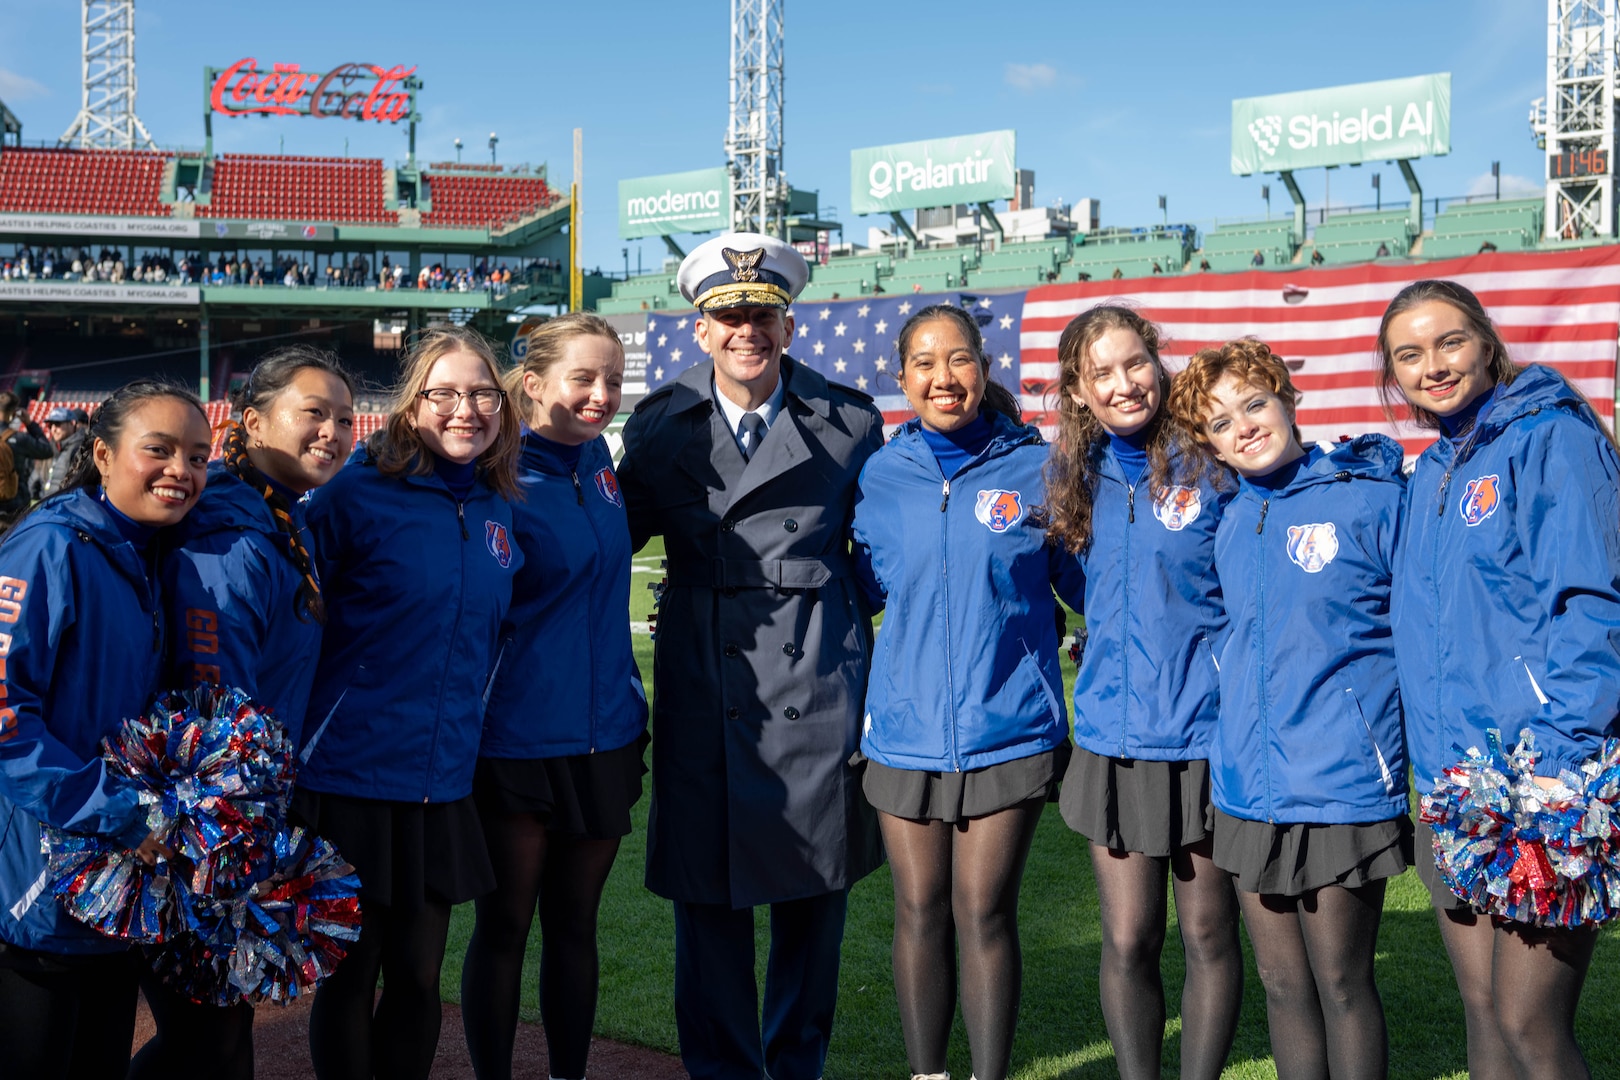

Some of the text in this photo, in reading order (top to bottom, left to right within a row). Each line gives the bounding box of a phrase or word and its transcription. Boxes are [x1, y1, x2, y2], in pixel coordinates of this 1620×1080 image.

[1288, 101, 1433, 150] Shield AI
[896, 150, 994, 193] Palantir
[628, 189, 720, 217] moderna
[33, 219, 72, 230] HELPING
[74, 221, 117, 231] COASTIES
[127, 223, 188, 233] MYCGMA.ORG
[33, 287, 72, 297] HELPING
[74, 288, 117, 297] COASTIES
[127, 289, 188, 299] MYCGMA.ORG
[0, 575, 28, 624] GO
[186, 608, 218, 655] GO
